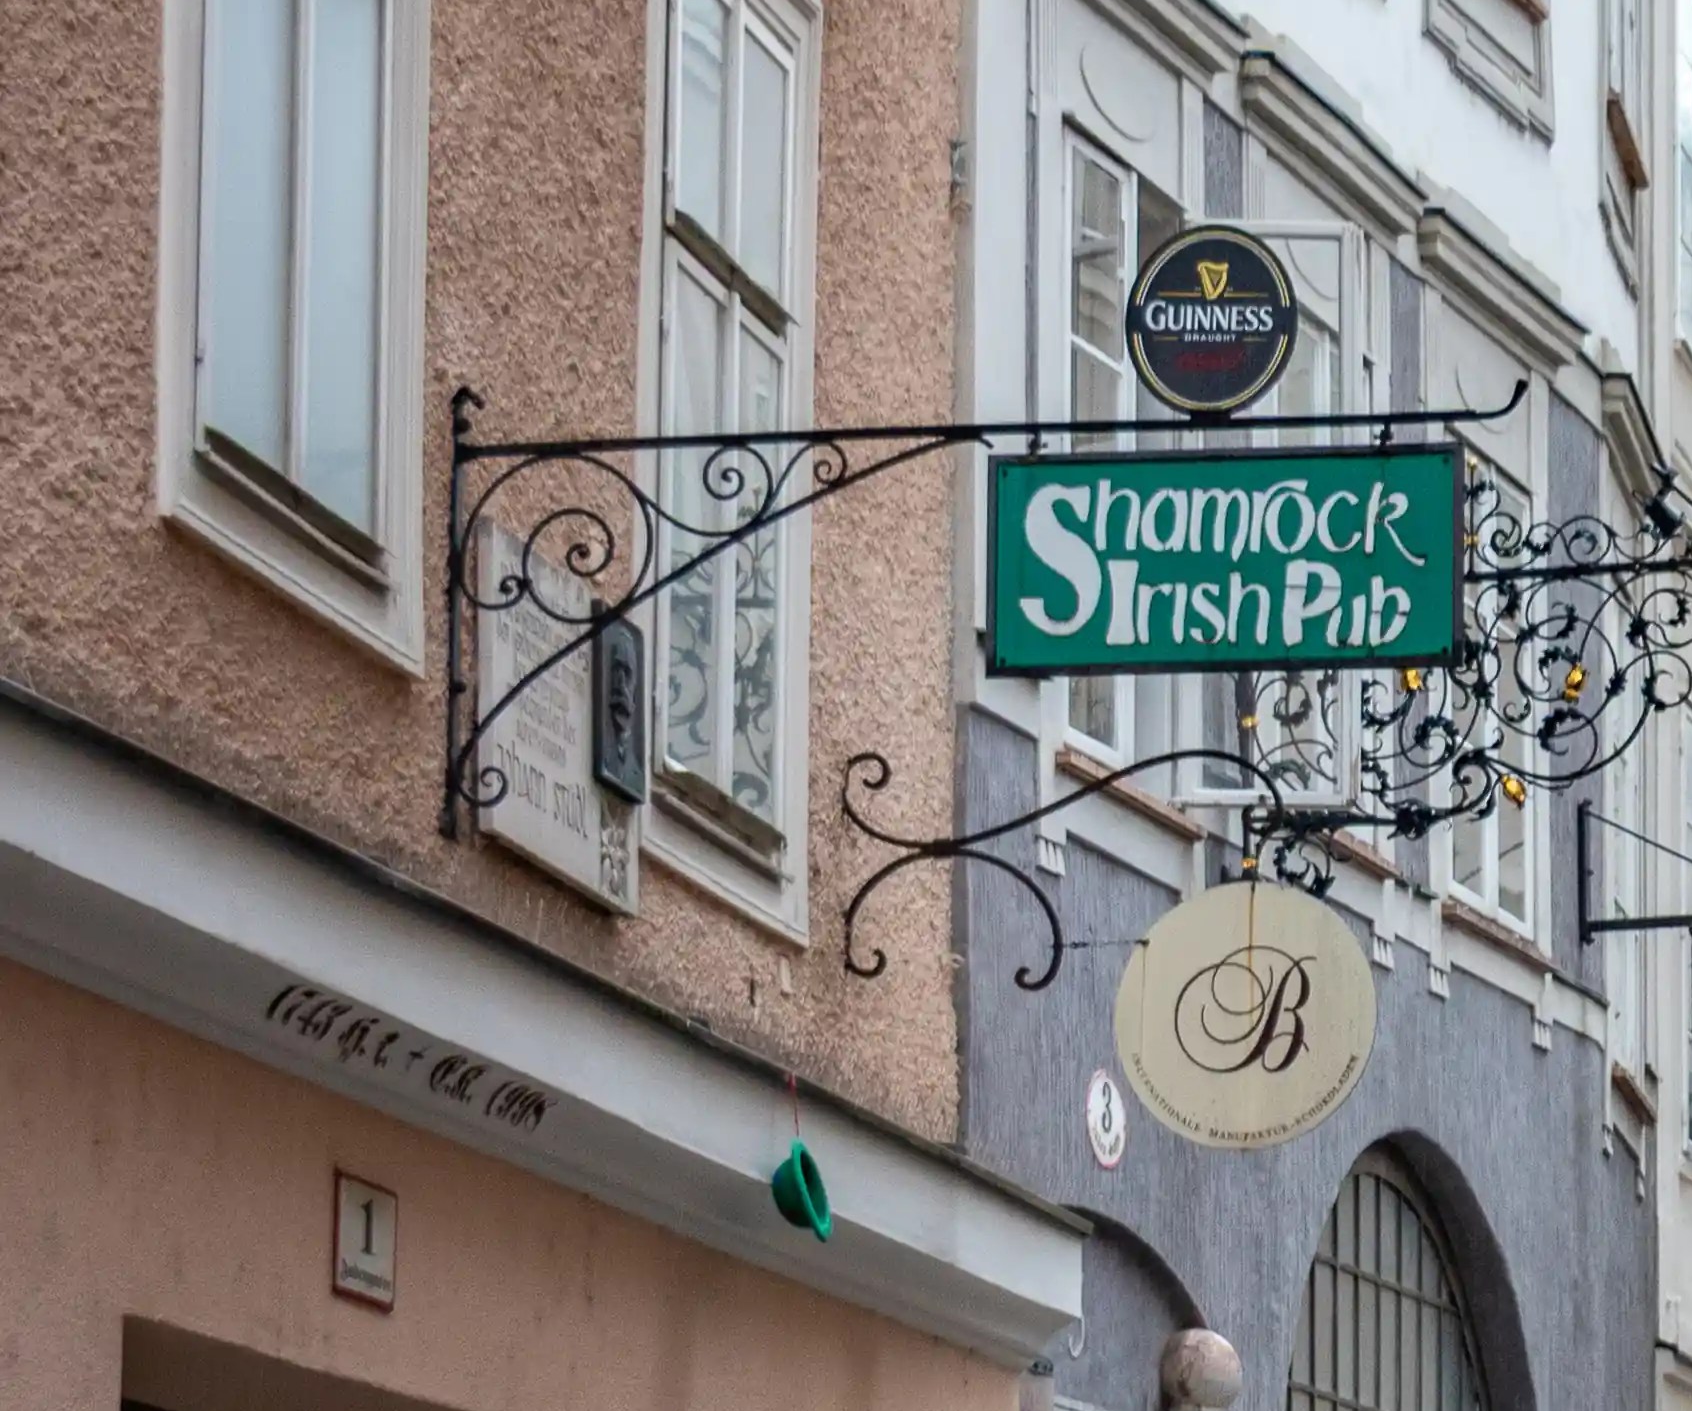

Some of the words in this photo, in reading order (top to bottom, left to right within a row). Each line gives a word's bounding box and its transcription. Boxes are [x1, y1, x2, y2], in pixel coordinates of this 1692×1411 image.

[1145, 299, 1274, 332] GUINNESS
[1184, 333, 1236, 343] DRAUGHT
[1019, 478, 1426, 636] Shamrock
[1105, 559, 1271, 646] Irish
[1282, 559, 1411, 648] Pub
[1174, 945, 1318, 1073] B
[1102, 1081, 1112, 1133] 3
[360, 1197, 376, 1256] 1
